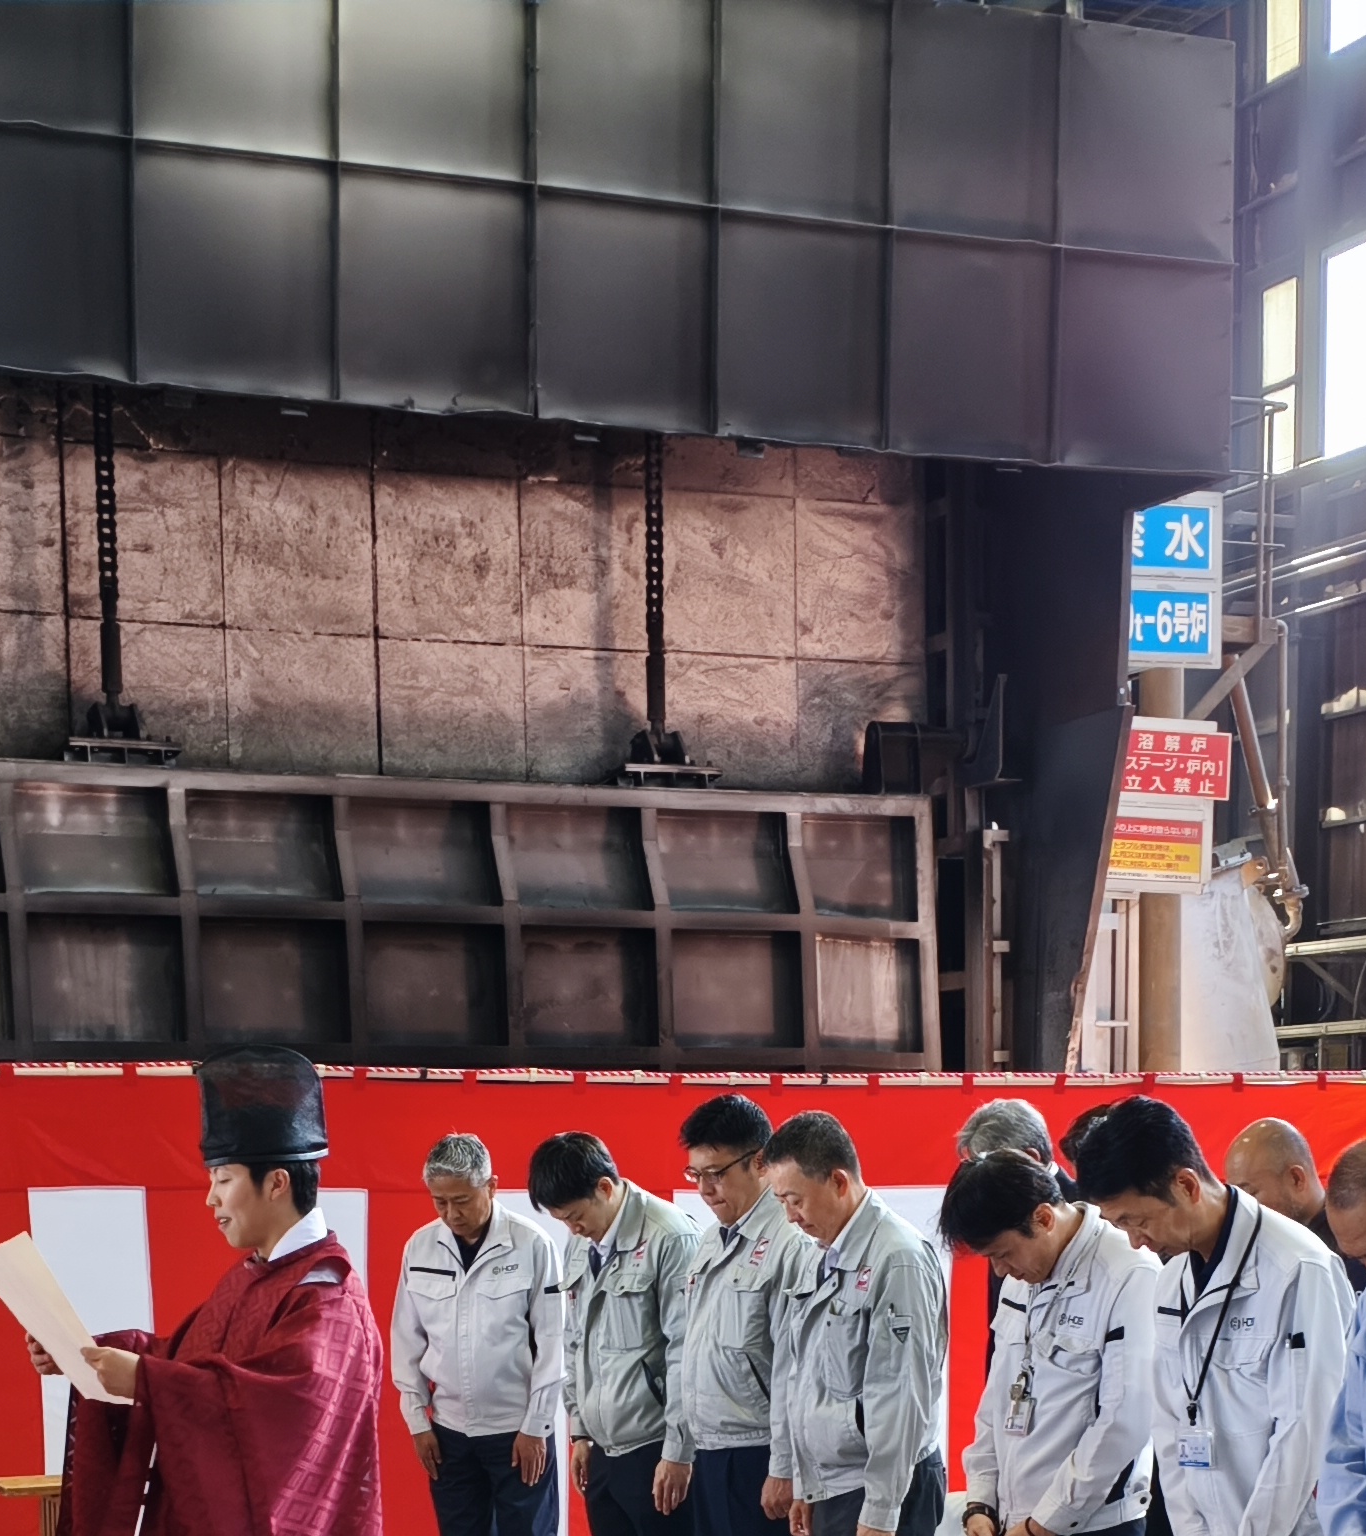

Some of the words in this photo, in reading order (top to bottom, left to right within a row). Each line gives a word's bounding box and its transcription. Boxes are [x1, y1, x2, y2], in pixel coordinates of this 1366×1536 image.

[1137, 733, 1207, 753] 溶解炉
[1124, 775, 1215, 795] 立入禁止
